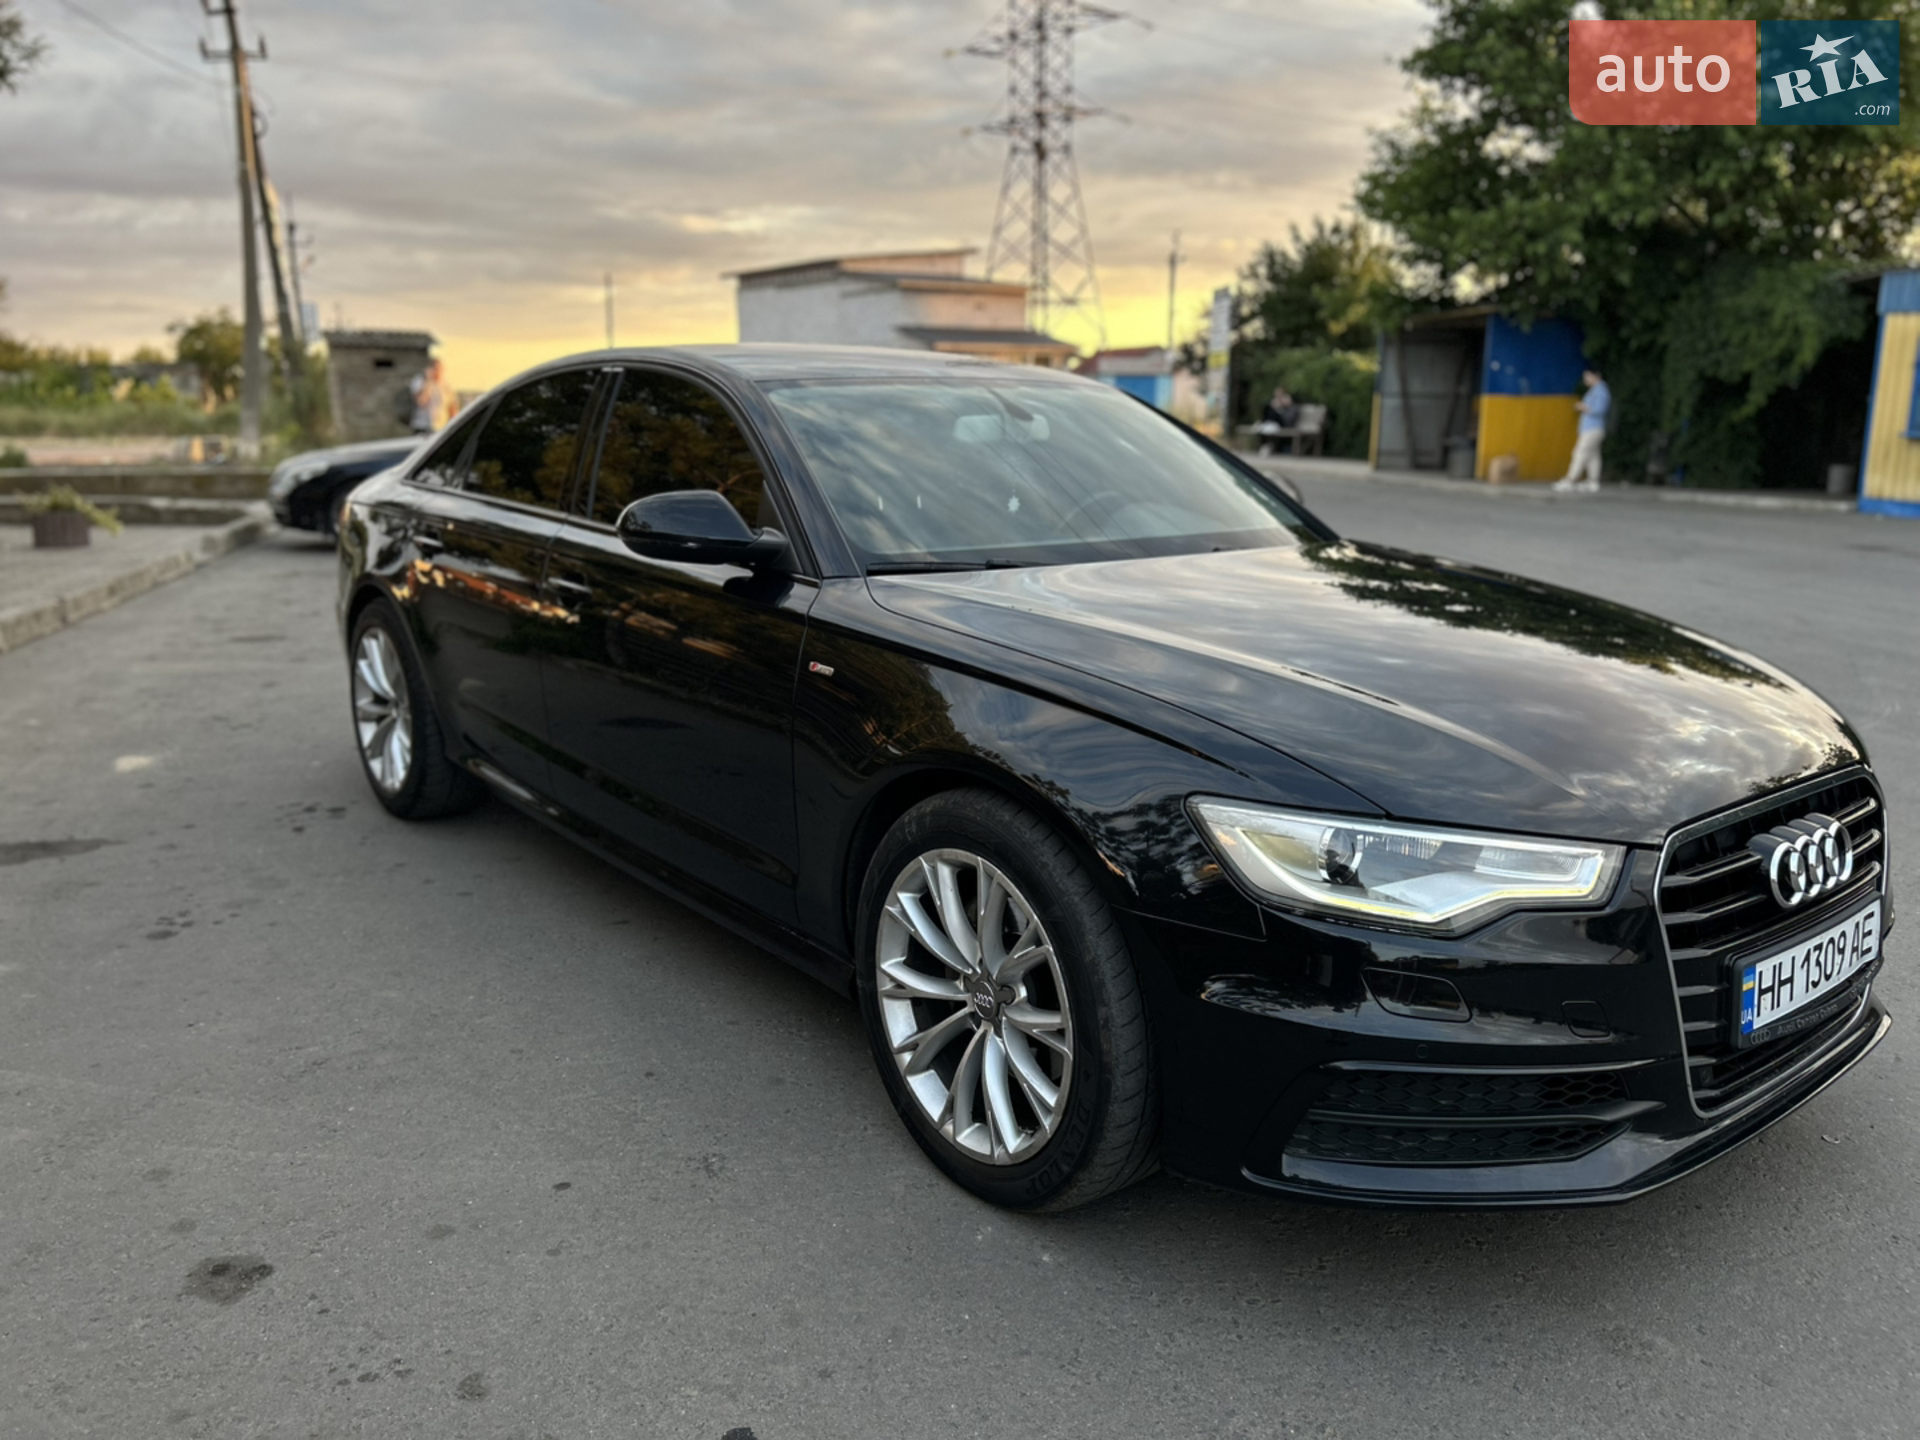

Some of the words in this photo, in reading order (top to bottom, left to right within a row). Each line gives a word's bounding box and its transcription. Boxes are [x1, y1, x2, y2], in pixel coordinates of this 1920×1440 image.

[1757, 955, 1796, 1018] HH
[1800, 930, 1847, 993] 1309
[1849, 911, 1875, 968] AE
[1741, 1007, 1753, 1025] UA
[1025, 1097, 1092, 1197] DUNLOP
